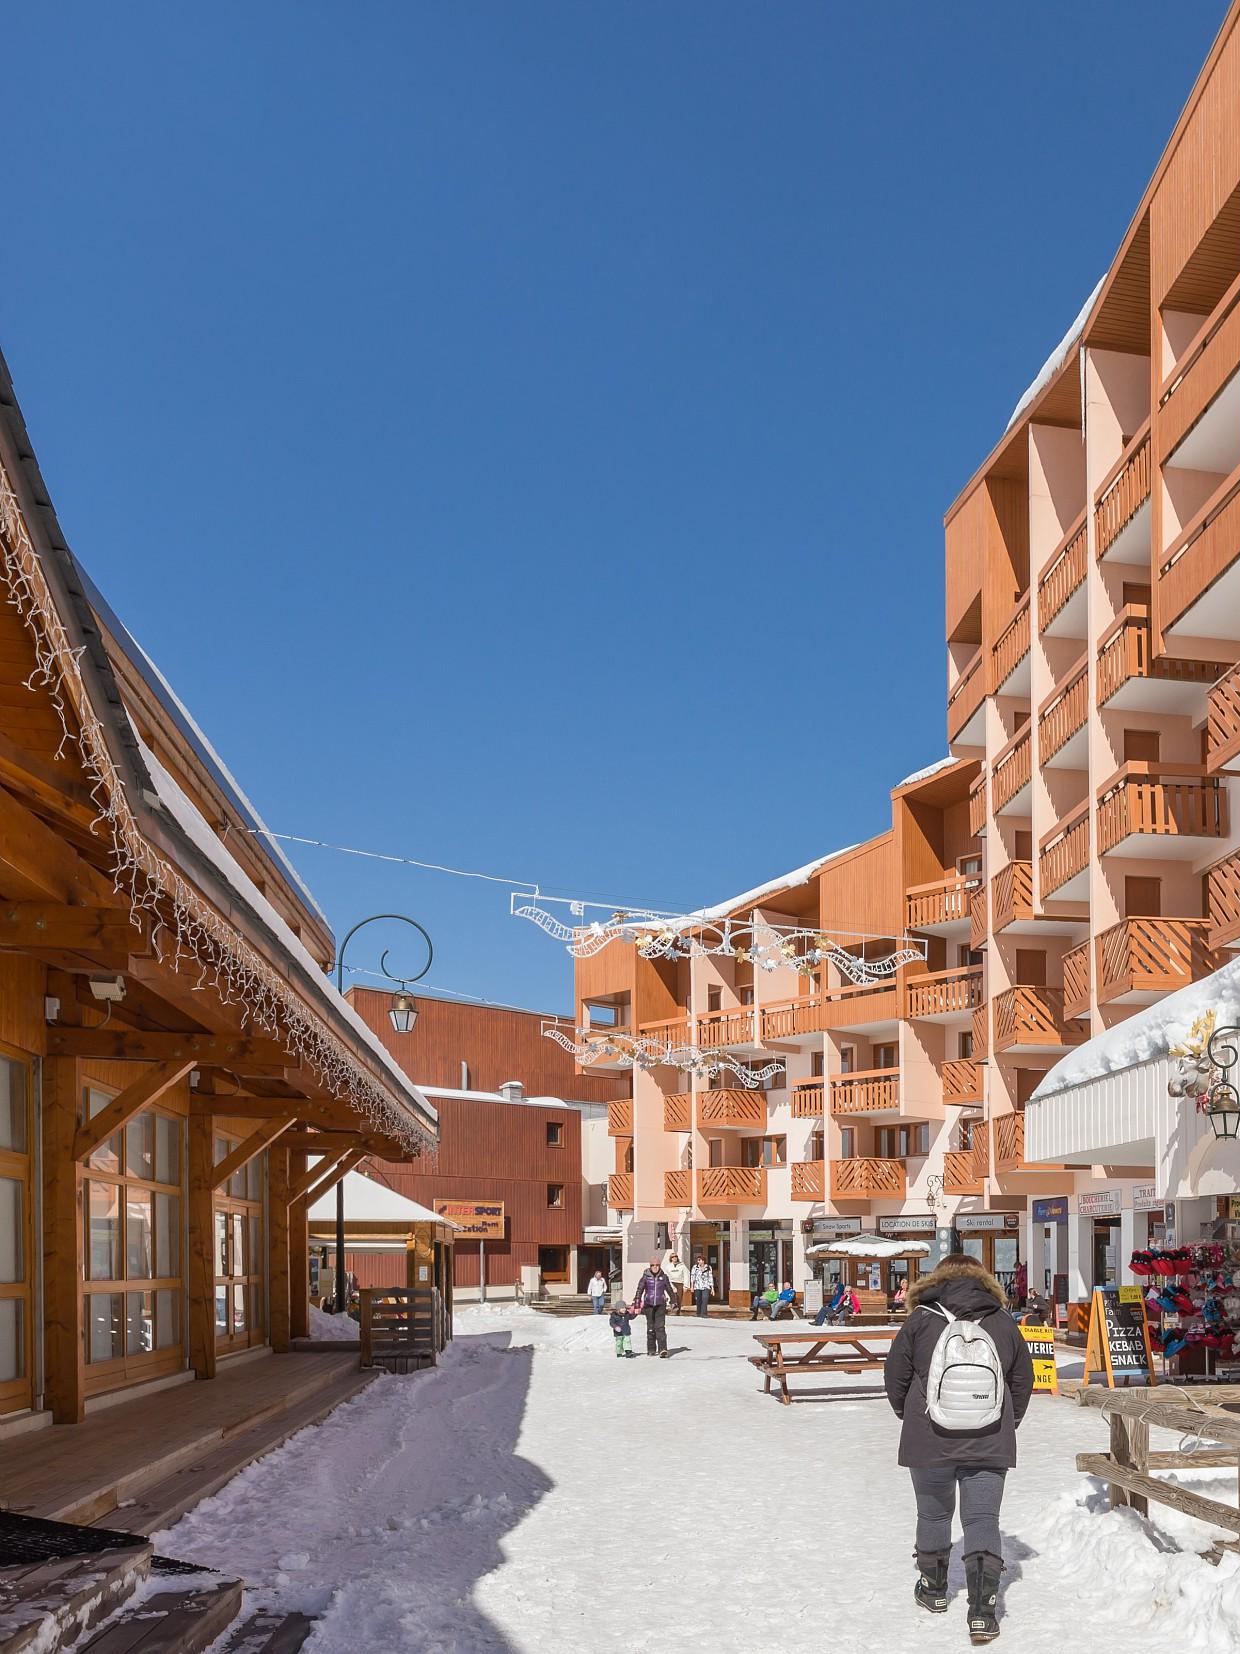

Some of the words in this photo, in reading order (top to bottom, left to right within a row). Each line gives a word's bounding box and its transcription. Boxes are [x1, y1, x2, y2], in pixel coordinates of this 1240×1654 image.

[977, 1218, 994, 1226] rental
[1106, 1319, 1143, 1338] PIZZA
[1109, 1340, 1144, 1352] KEBAB
[1111, 1354, 1147, 1366] SNACK
